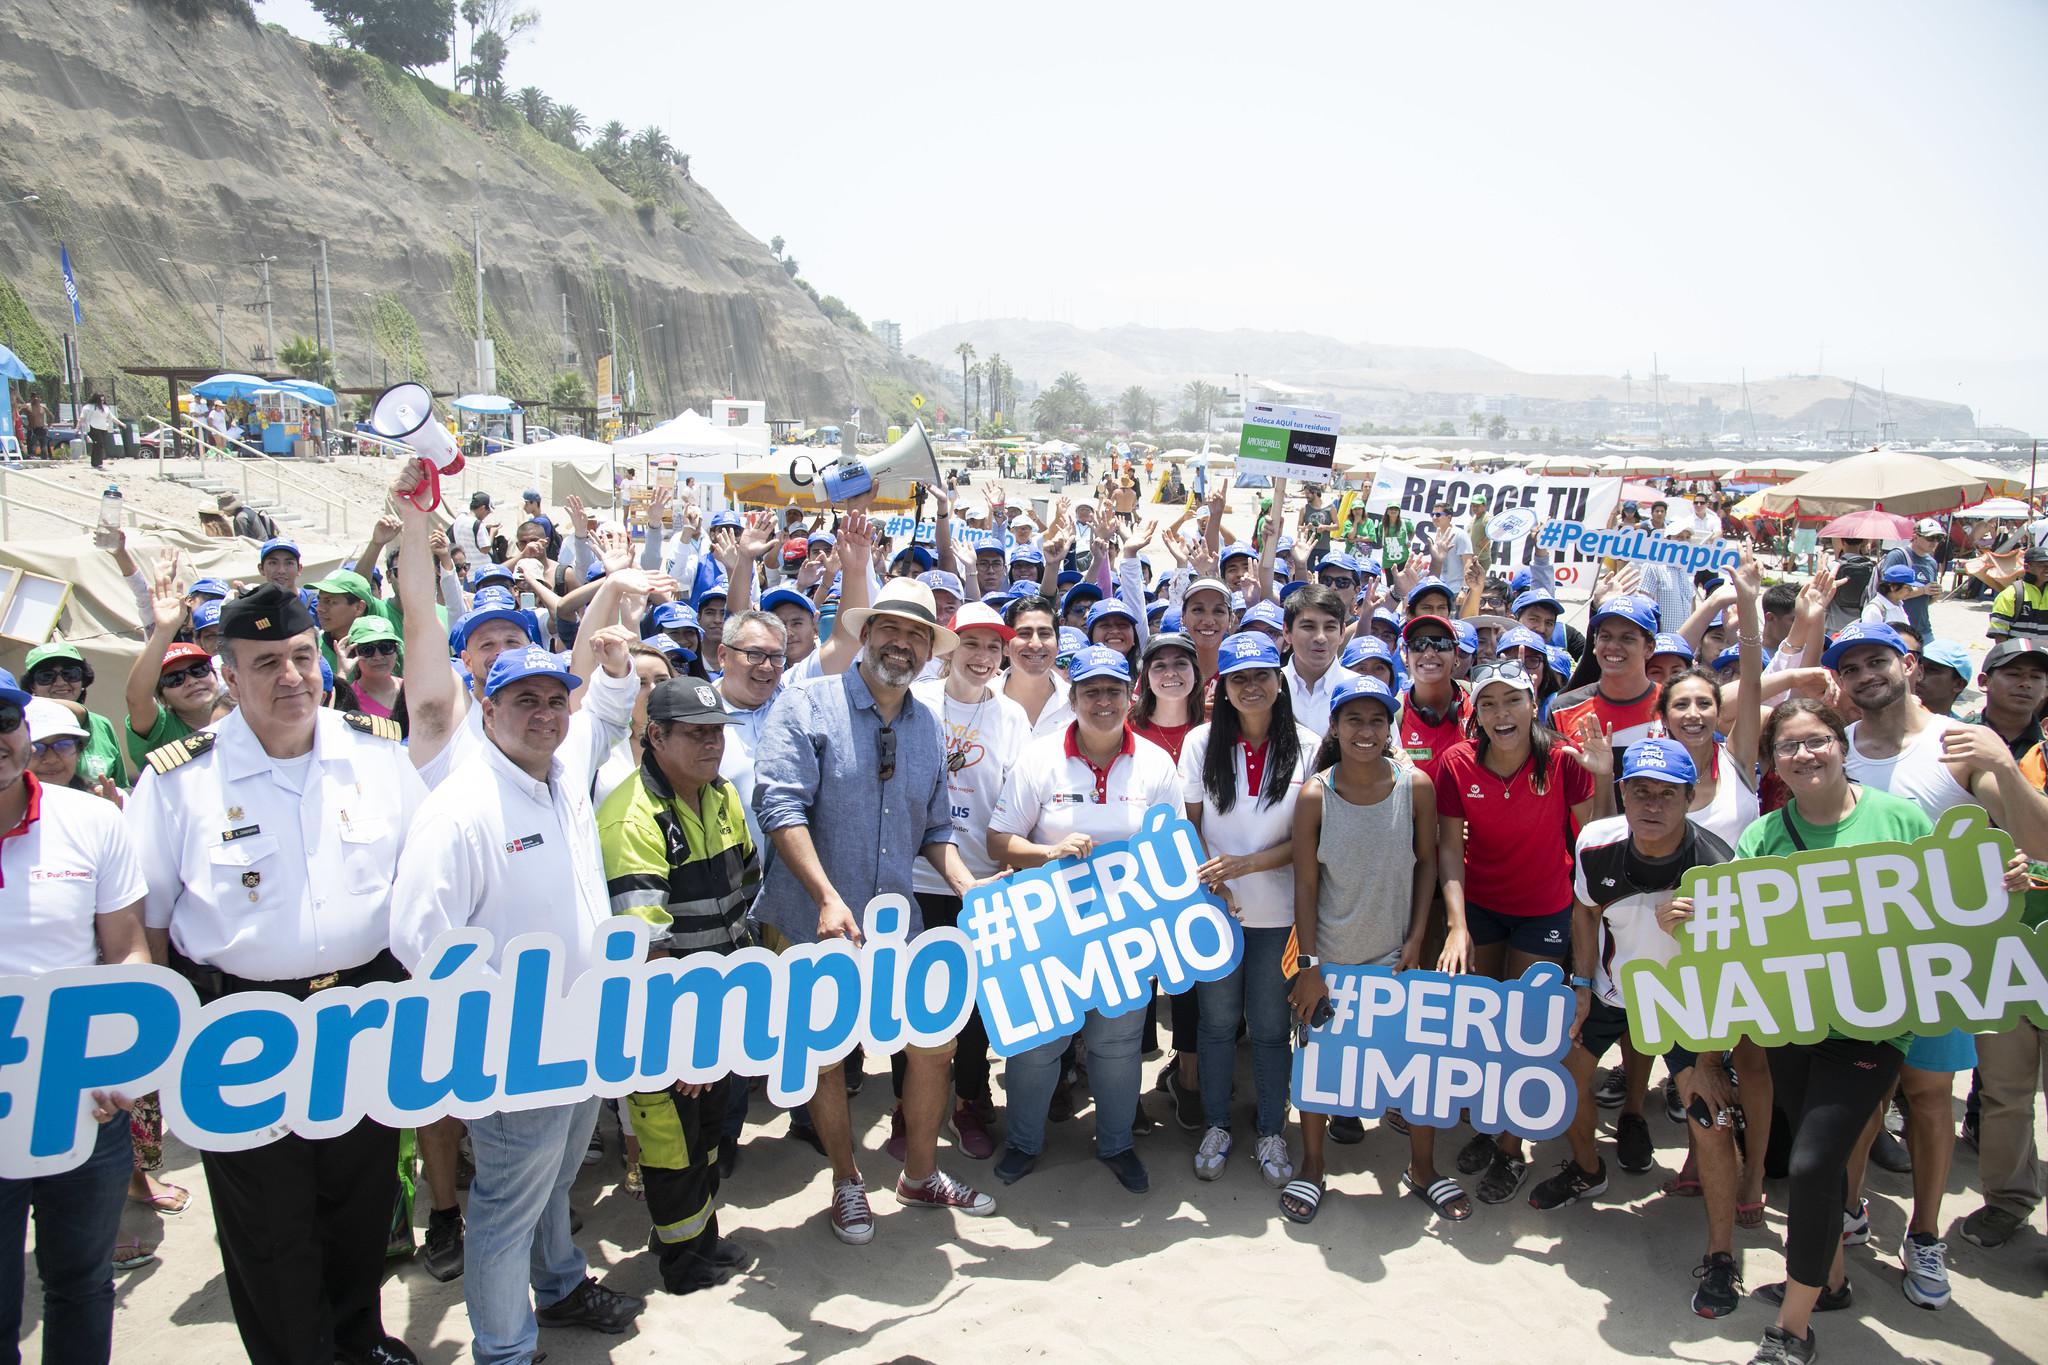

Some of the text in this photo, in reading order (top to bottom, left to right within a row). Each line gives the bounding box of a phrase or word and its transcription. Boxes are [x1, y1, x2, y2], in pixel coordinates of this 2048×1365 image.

[1252, 416, 1274, 425] Coloca
[1304, 423, 1331, 432] residuos
[1401, 476, 1590, 522] RECOGE TU
[1540, 522, 1741, 574] #PerúLimpio
[1636, 759, 1667, 768] LIMPIO
[968, 813, 1199, 968] #PERÚ
[1686, 818, 2010, 953] #PERÚ
[982, 903, 1235, 1047] LIMPIO
[1311, 973, 1565, 1057] #PERÚ
[1633, 936, 2048, 1044] NATURA
[0, 907, 969, 1157] PerúLimpio
[1301, 1042, 1567, 1131] LIMPIO
